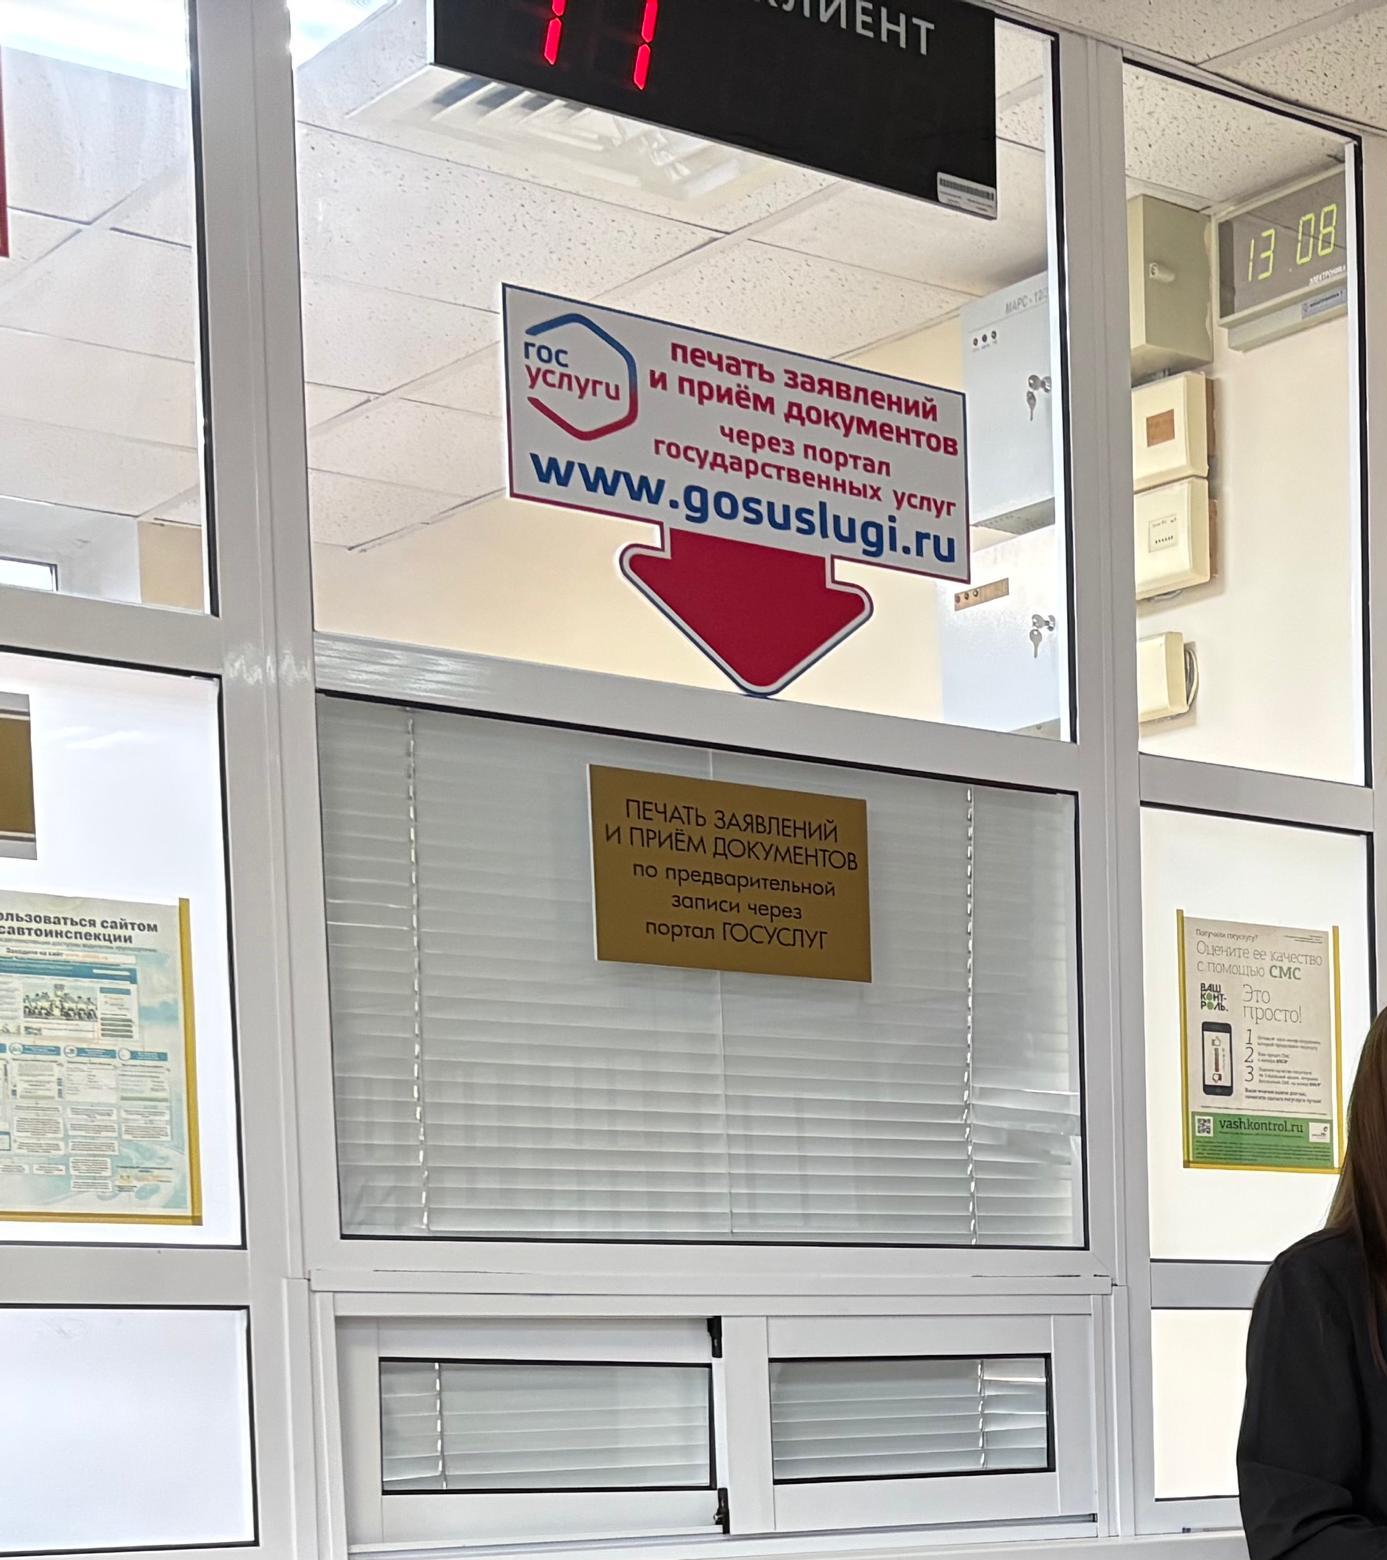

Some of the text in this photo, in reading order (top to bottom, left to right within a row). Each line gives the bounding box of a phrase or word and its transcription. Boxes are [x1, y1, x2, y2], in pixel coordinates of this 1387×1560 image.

[752, 0, 935, 56] ЛИЕНТ
[1248, 204, 1337, 282] 13 08
[524, 340, 569, 368] гос
[670, 341, 939, 422] печать заявлений
[649, 369, 959, 457] и приём документов
[719, 424, 892, 477] через портал
[653, 437, 957, 519] государственных услуг
[530, 452, 957, 564] www.gosuslugi.ru
[625, 798, 839, 844] ПЕЧАТЬ ЗАЯВЛЕНИЙ
[605, 823, 859, 872] И ПРИЁМ ДОКУМЕНТОВ
[633, 863, 836, 897] по предварительной
[671, 894, 803, 923] записи через
[100, 917, 159, 933] сайтом
[645, 921, 829, 950] портал ГОСУСЛУГ
[1196, 940, 1323, 967] Оцените ее качество
[1196, 960, 1302, 981] с помощью СМС
[1200, 982, 1222, 993] ВАШ
[1242, 983, 1271, 1005] Это
[1242, 1004, 1302, 1025] просто!
[1246, 1028, 1253, 1046] 1
[1244, 1046, 1255, 1063] 2
[1244, 1065, 1255, 1083] 3
[1218, 1117, 1304, 1133] vashkontrol.ru
